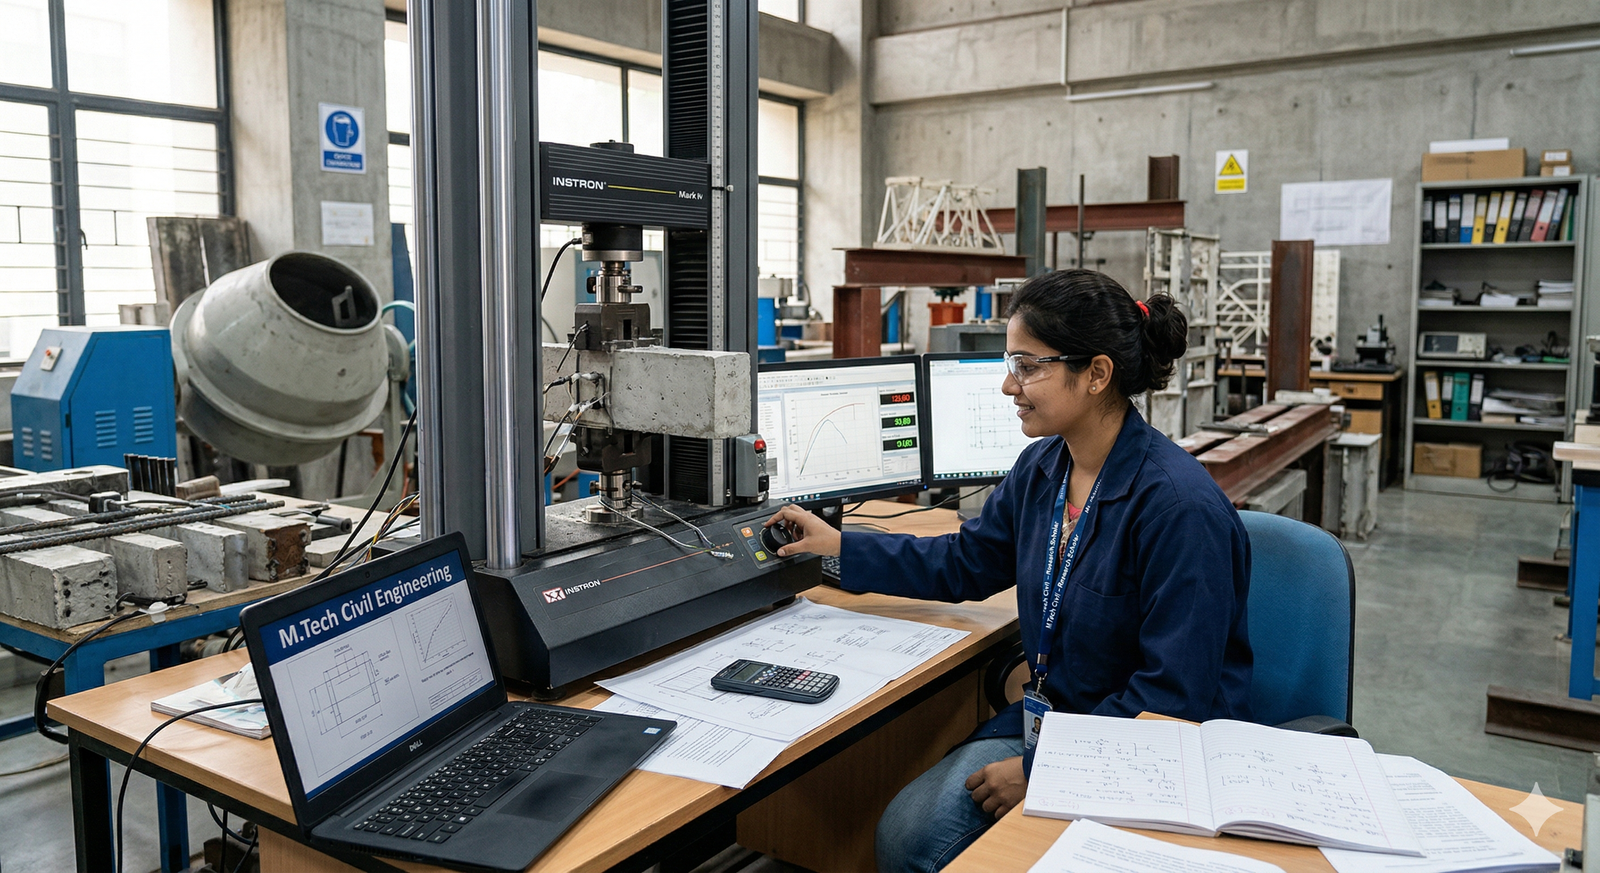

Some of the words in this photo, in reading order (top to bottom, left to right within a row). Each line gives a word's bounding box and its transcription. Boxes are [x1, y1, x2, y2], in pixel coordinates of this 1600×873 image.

[553, 176, 605, 190] INSTRON
[679, 190, 696, 200] Mark
[565, 579, 601, 595] INSTRON
[278, 609, 339, 649] M.Tech
[341, 592, 374, 622] Civil
[375, 565, 453, 608] Engineering
[409, 739, 423, 752] DELL
